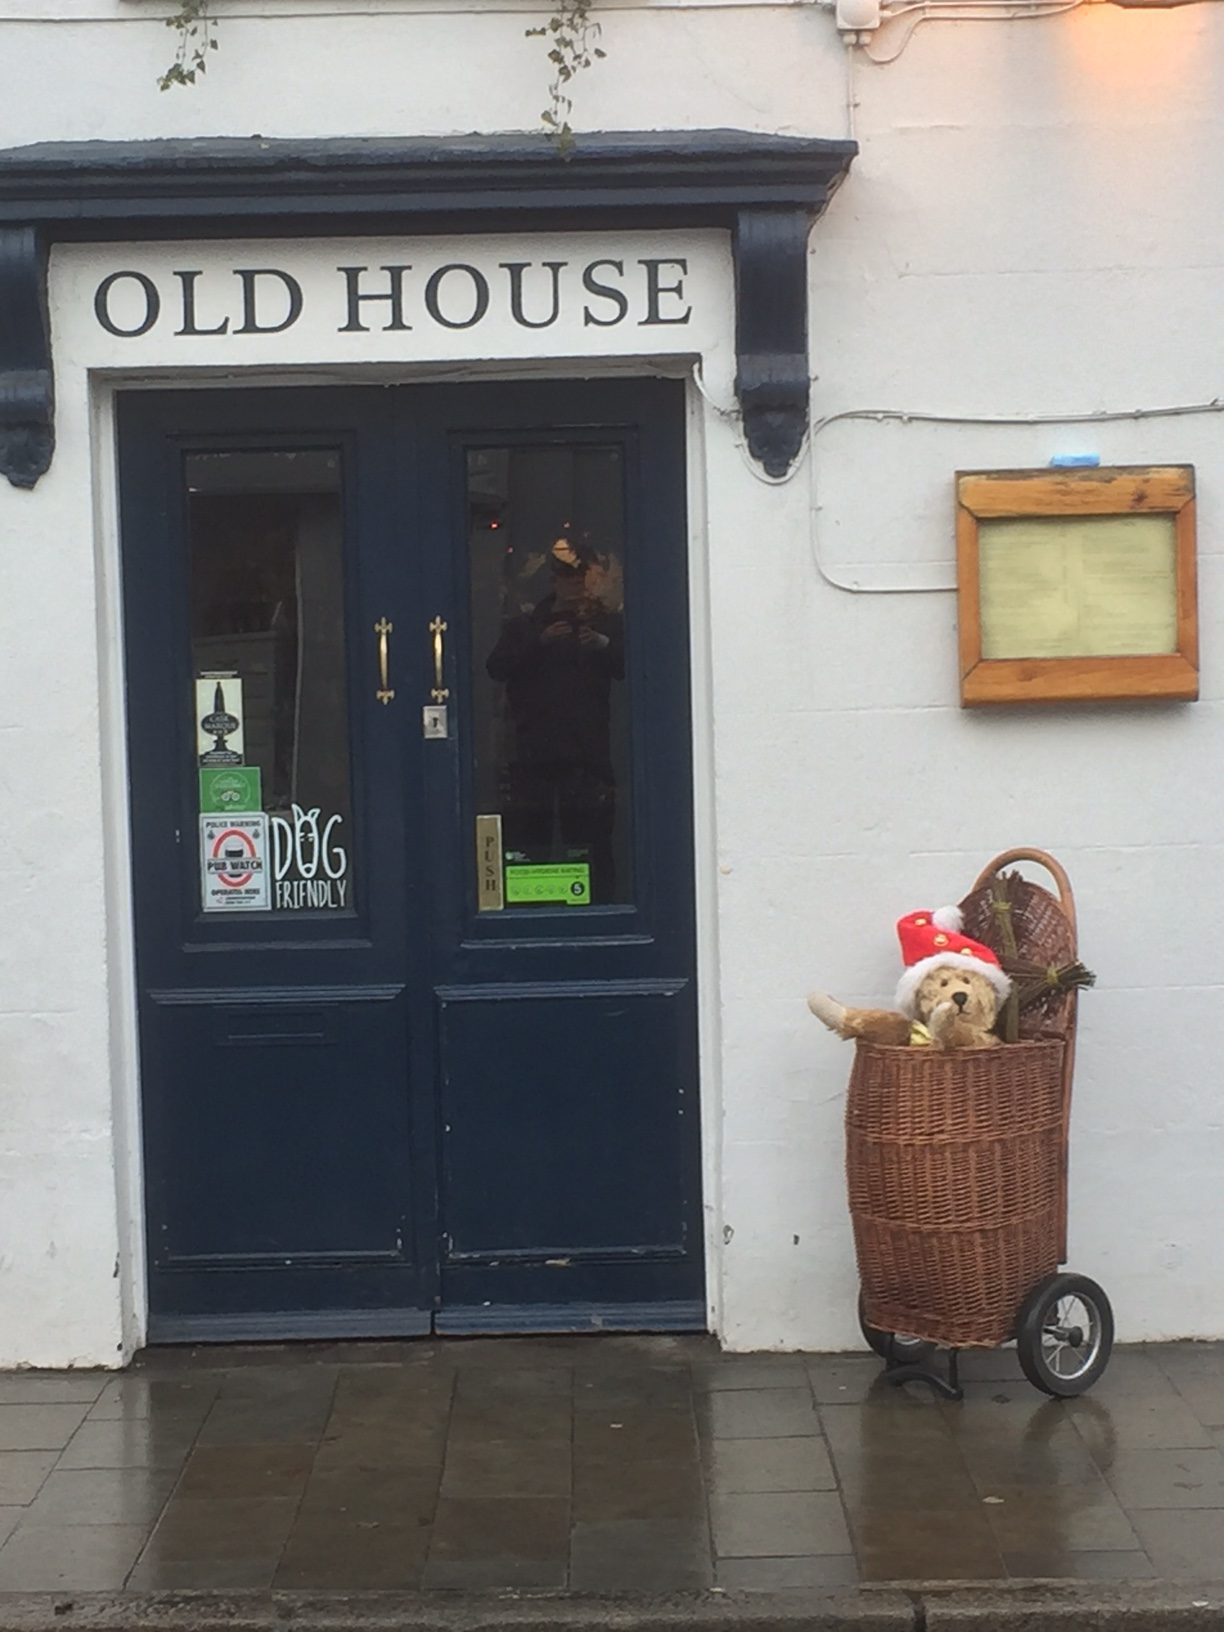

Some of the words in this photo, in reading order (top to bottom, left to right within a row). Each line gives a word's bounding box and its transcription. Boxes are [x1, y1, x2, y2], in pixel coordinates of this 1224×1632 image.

[93, 267, 304, 338] OLD
[336, 258, 693, 333] HOUSE
[207, 861, 227, 871] PUB
[231, 860, 263, 870] WATCH
[271, 804, 348, 881] DOG
[484, 836, 496, 892] PUSH
[573, 883, 582, 894] 5
